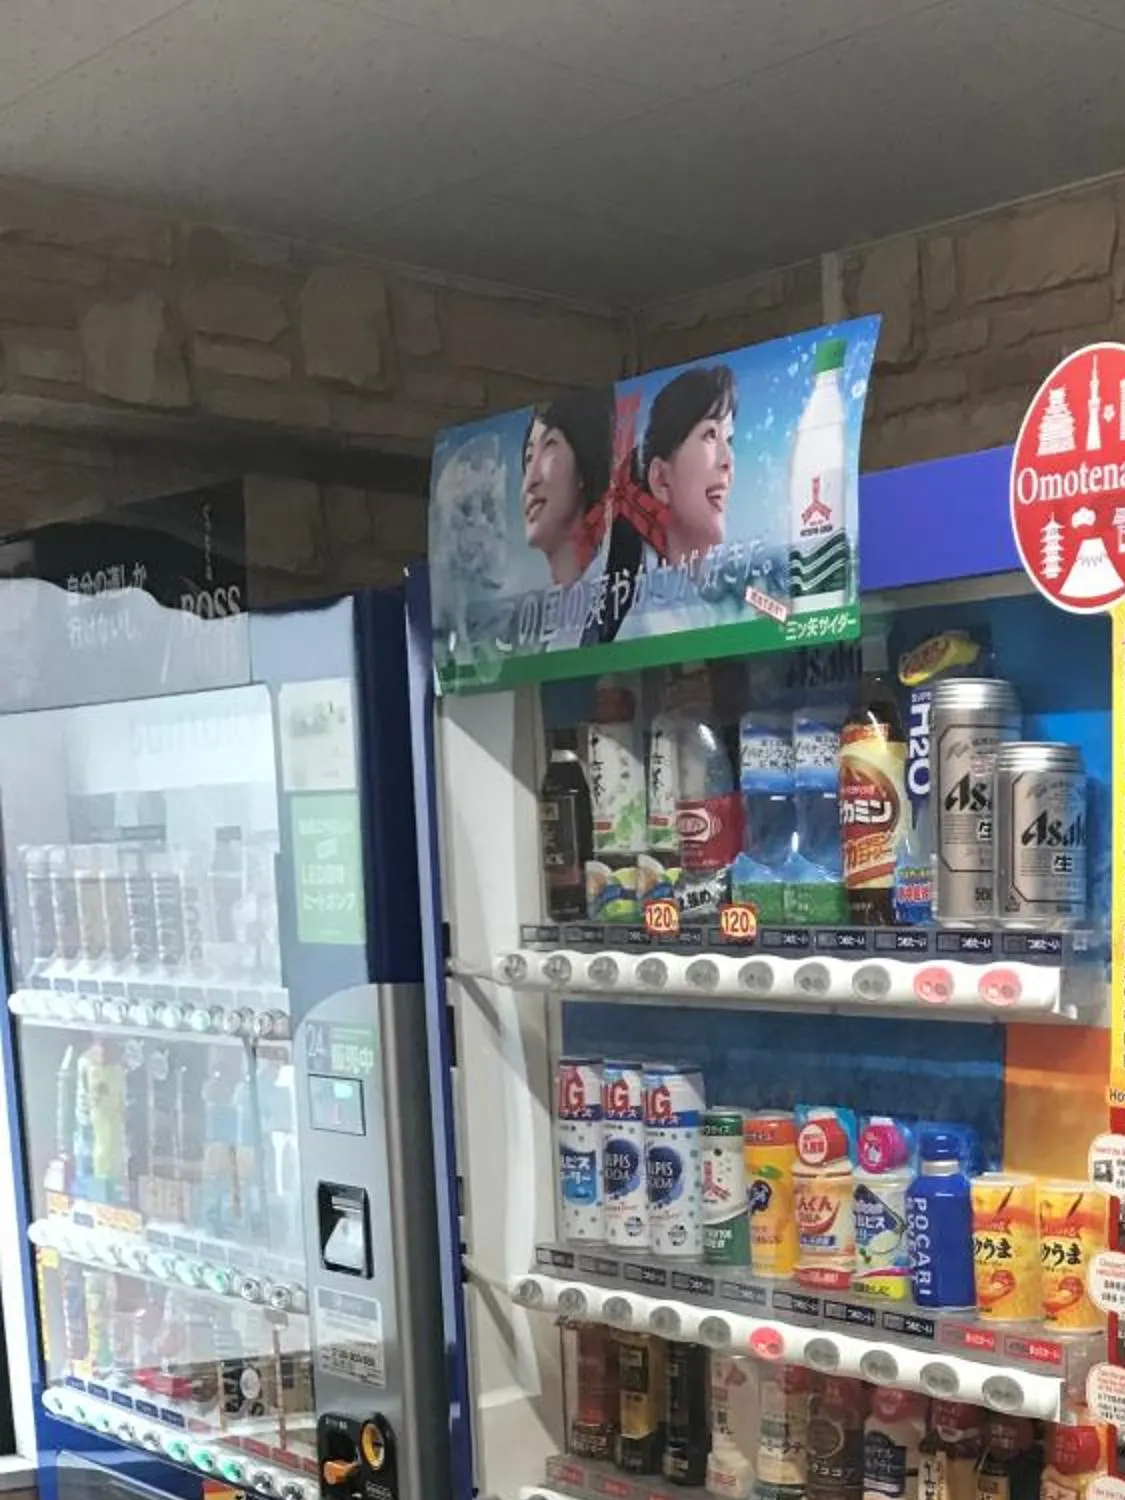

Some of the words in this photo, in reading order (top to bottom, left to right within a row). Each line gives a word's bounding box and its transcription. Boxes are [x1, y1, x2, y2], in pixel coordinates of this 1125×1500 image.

[646, 904, 672, 928] 120
[722, 911, 750, 934] 120
[913, 1197, 933, 1297] POCARI
